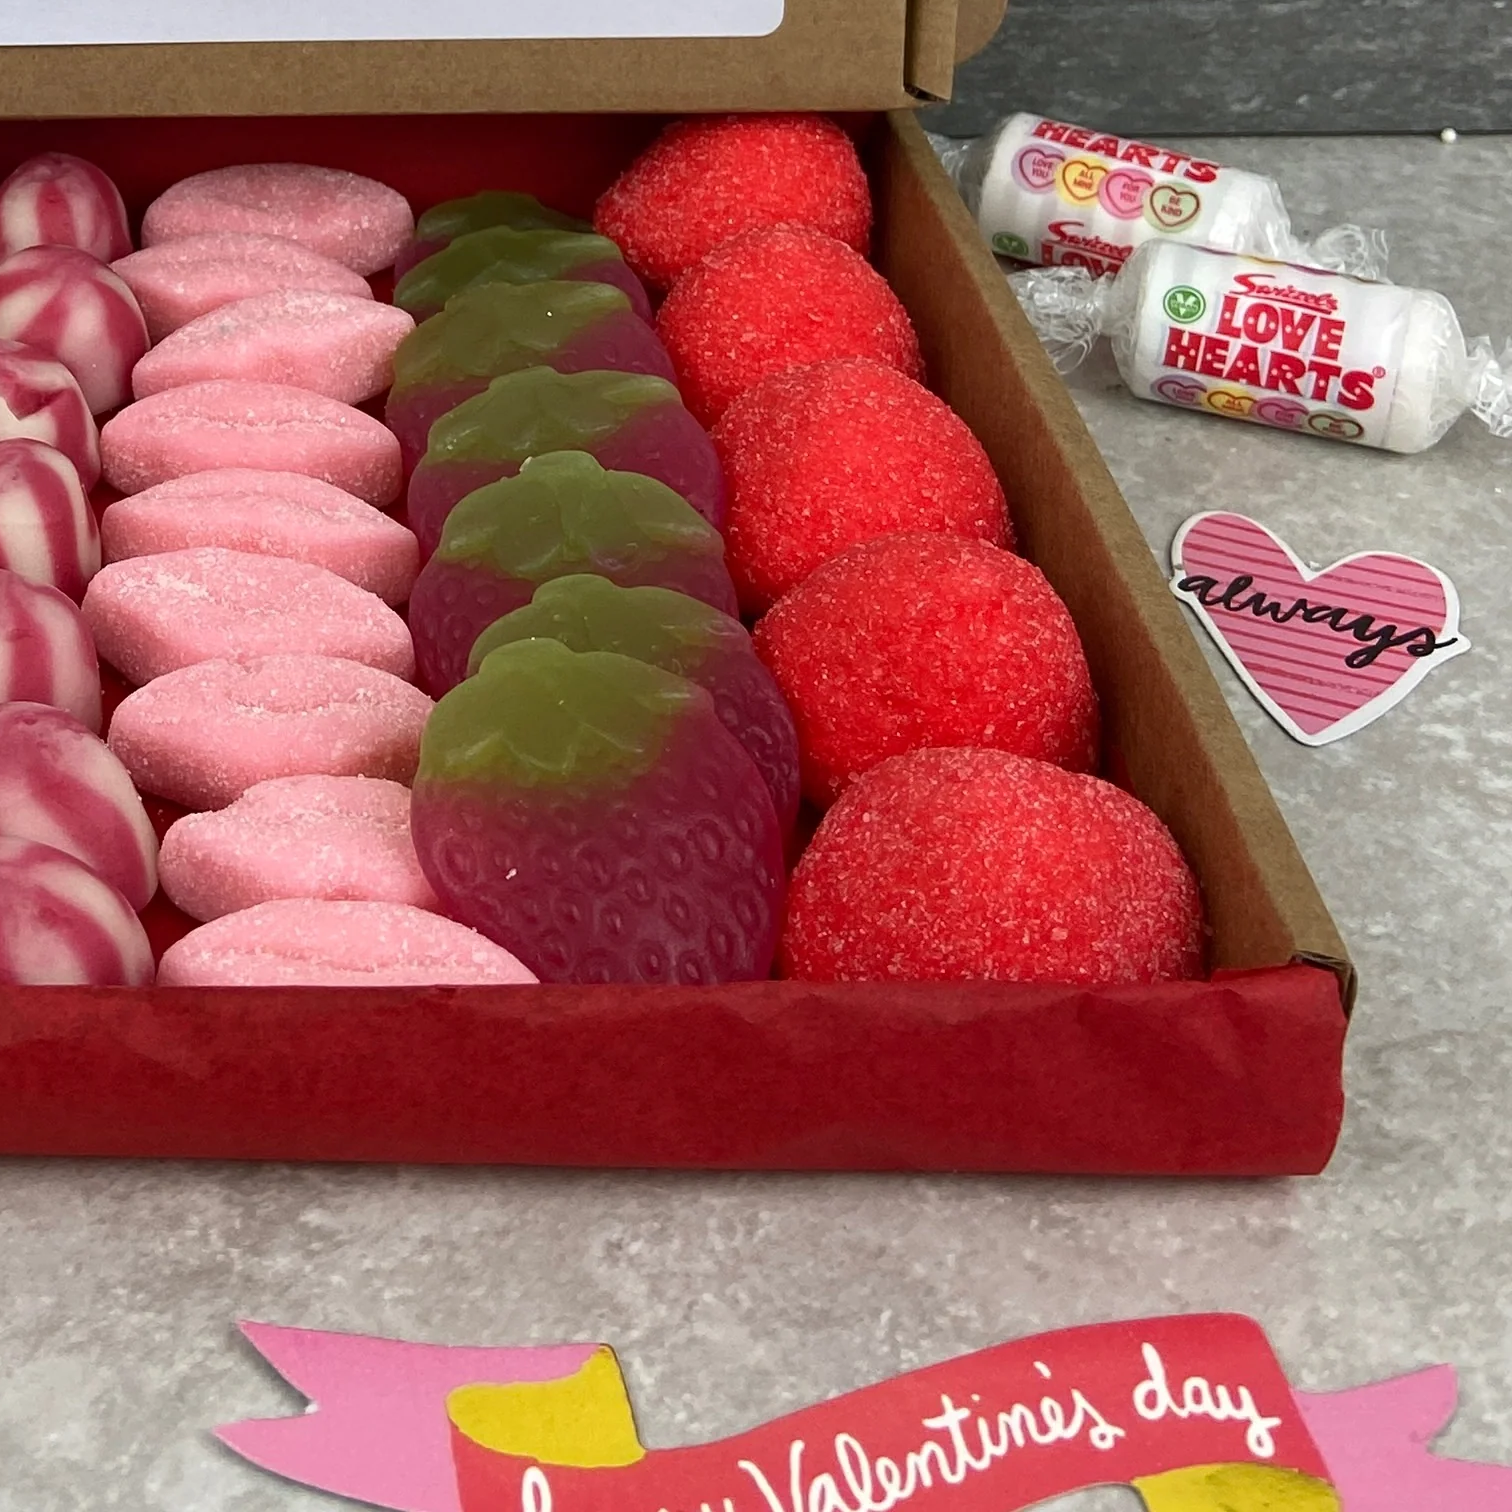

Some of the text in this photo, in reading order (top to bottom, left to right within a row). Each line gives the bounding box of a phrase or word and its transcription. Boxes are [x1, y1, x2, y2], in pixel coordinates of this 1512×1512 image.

[1032, 119, 1220, 183] HEARTS
[1032, 167, 1050, 178] YOU
[1161, 205, 1183, 218] KIND
[1169, 195, 1181, 206] BE
[1216, 294, 1346, 362] LOVE
[1162, 326, 1376, 411] HEARTS
[1177, 574, 1458, 669] always
[737, 1342, 1282, 1512] Valentine's day
